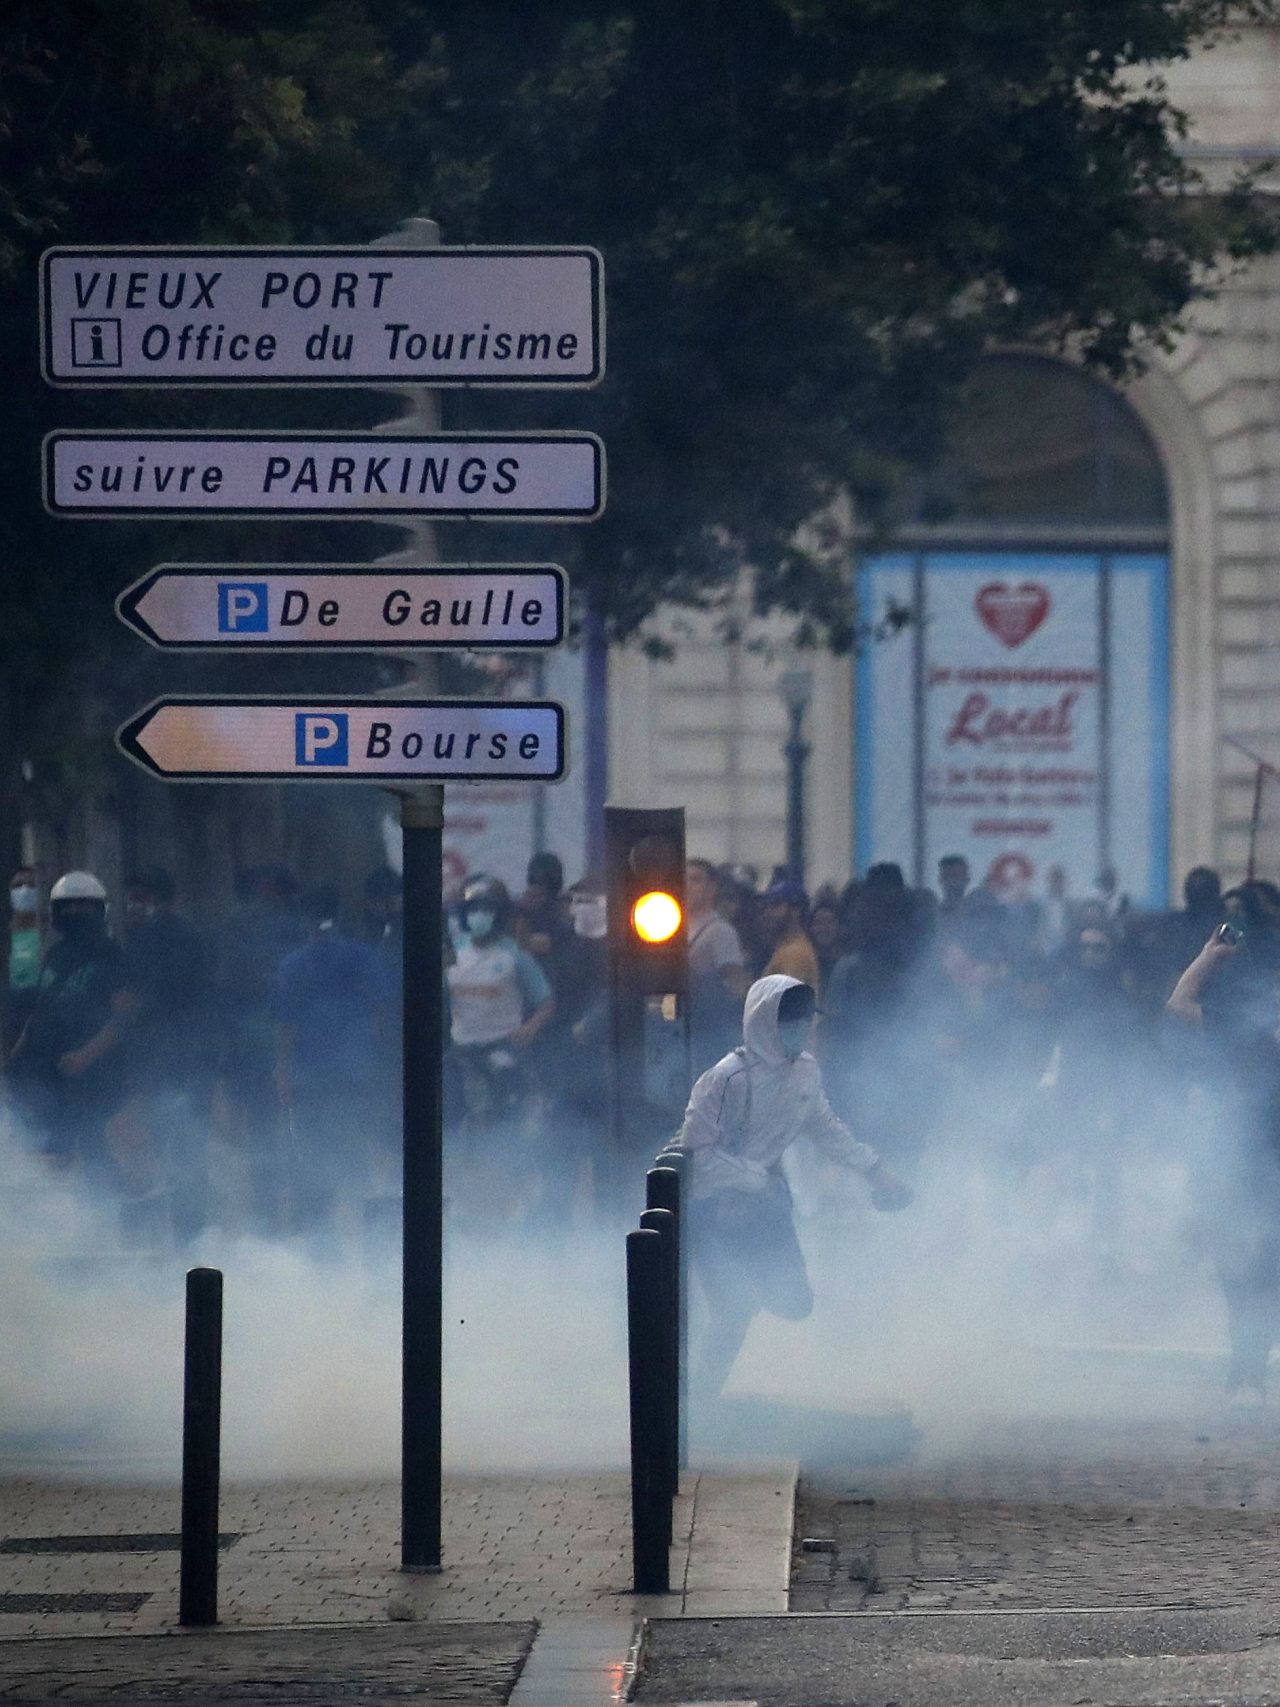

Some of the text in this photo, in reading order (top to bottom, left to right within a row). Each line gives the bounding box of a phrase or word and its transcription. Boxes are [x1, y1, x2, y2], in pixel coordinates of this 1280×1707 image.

[74, 272, 393, 309] VIEUX PORT
[142, 325, 277, 361] Office
[306, 324, 353, 361] du
[385, 324, 579, 361] Tourisme
[73, 457, 521, 494] suivre PARKINGS
[227, 589, 543, 630] P De Gaulle
[945, 690, 1080, 746] Local
[304, 717, 541, 762] P Bourse
